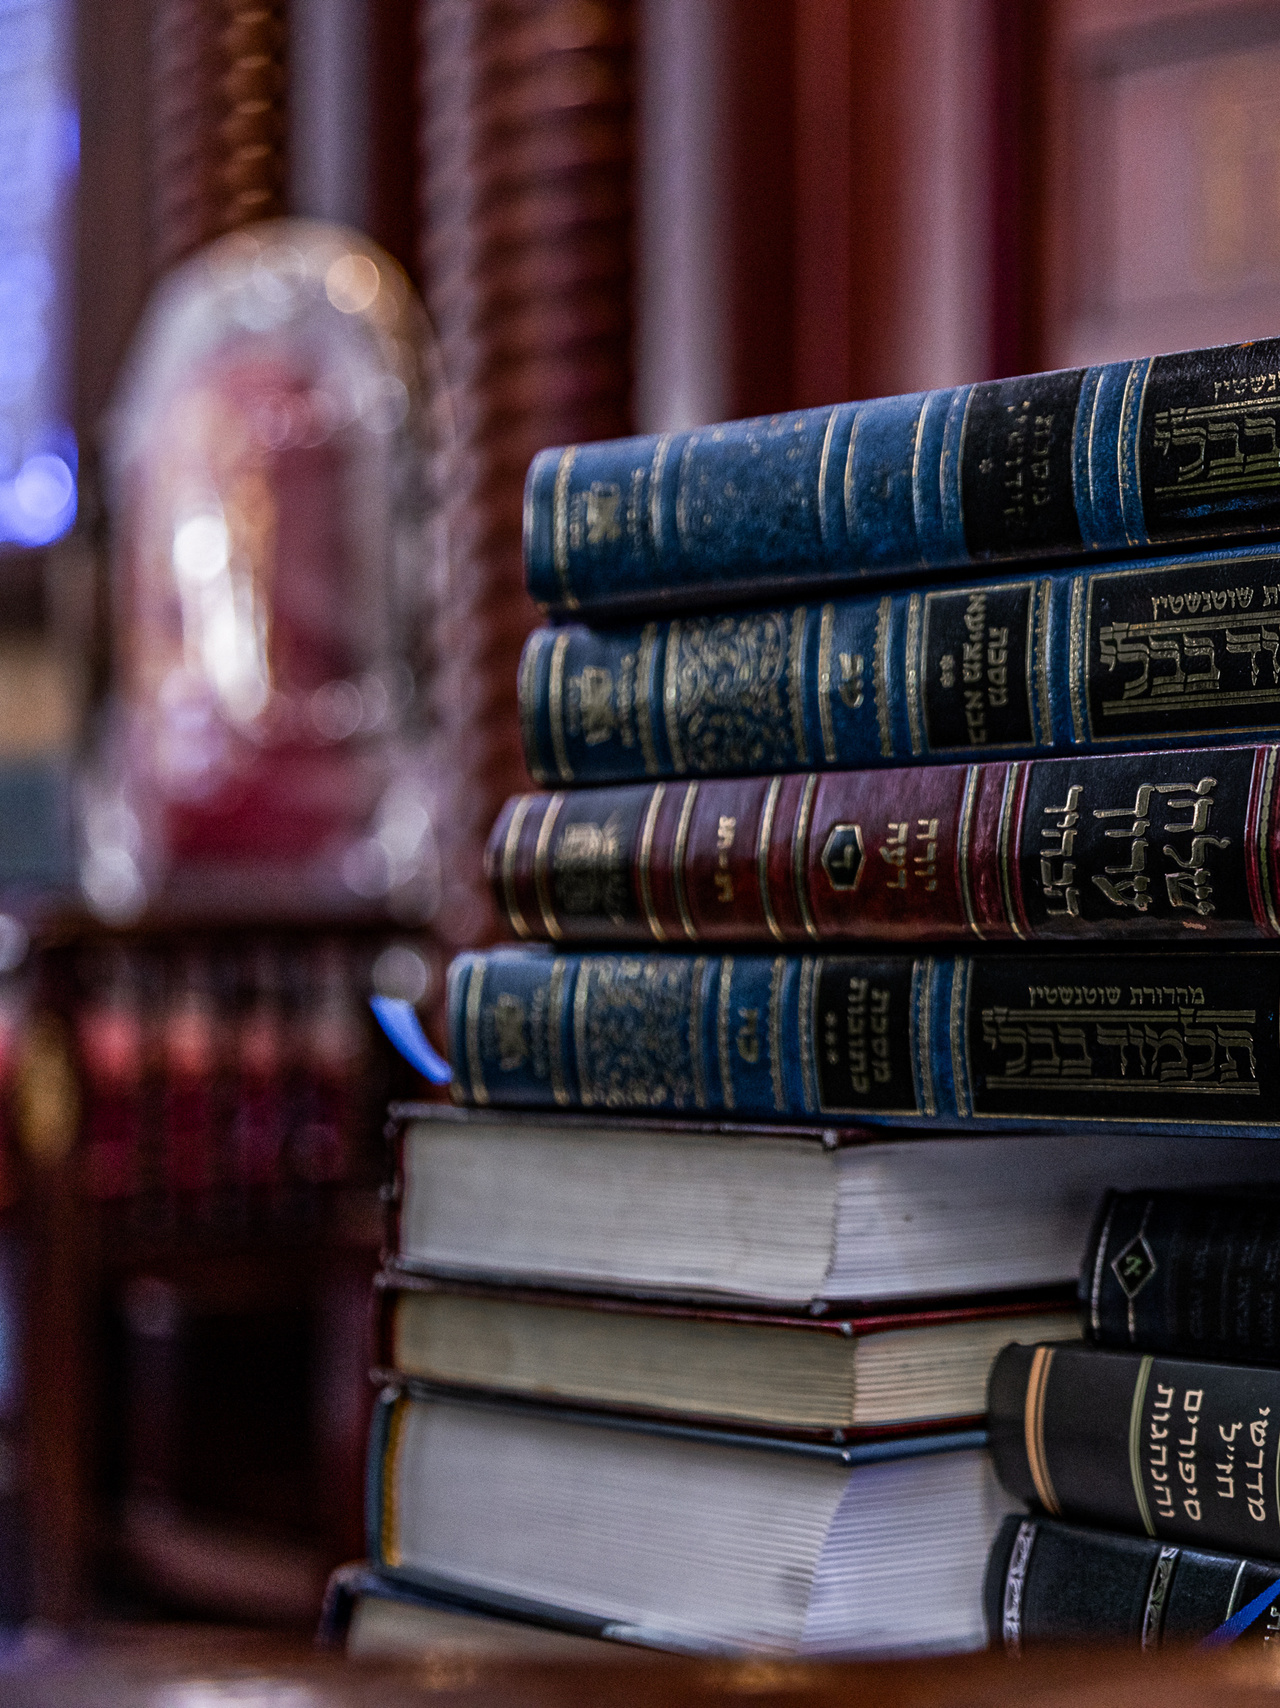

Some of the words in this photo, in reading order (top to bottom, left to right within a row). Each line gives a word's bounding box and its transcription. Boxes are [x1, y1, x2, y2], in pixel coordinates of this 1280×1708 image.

[962, 593, 988, 684] מציעא
[1151, 586, 1254, 620] שוטנשטין
[986, 626, 1010, 708] מסכת
[1099, 622, 1222, 700] בבלי
[962, 689, 987, 744] בבא
[878, 821, 909, 890] דעה
[914, 818, 940, 891] יורה
[1090, 782, 1157, 912] ערוך
[1153, 775, 1233, 916] שלחן
[846, 976, 872, 1095] כתובות
[869, 987, 893, 1084] מסכת
[1028, 985, 1122, 1008] שוטנשטין
[1129, 985, 1206, 1006] מהדורת
[982, 1006, 1094, 1077] בבלי
[1096, 1006, 1258, 1083] תלמוד
[1149, 1383, 1177, 1518] והנהגות
[1177, 1389, 1205, 1521] סיפורים
[1244, 1405, 1271, 1522] מדרשי
